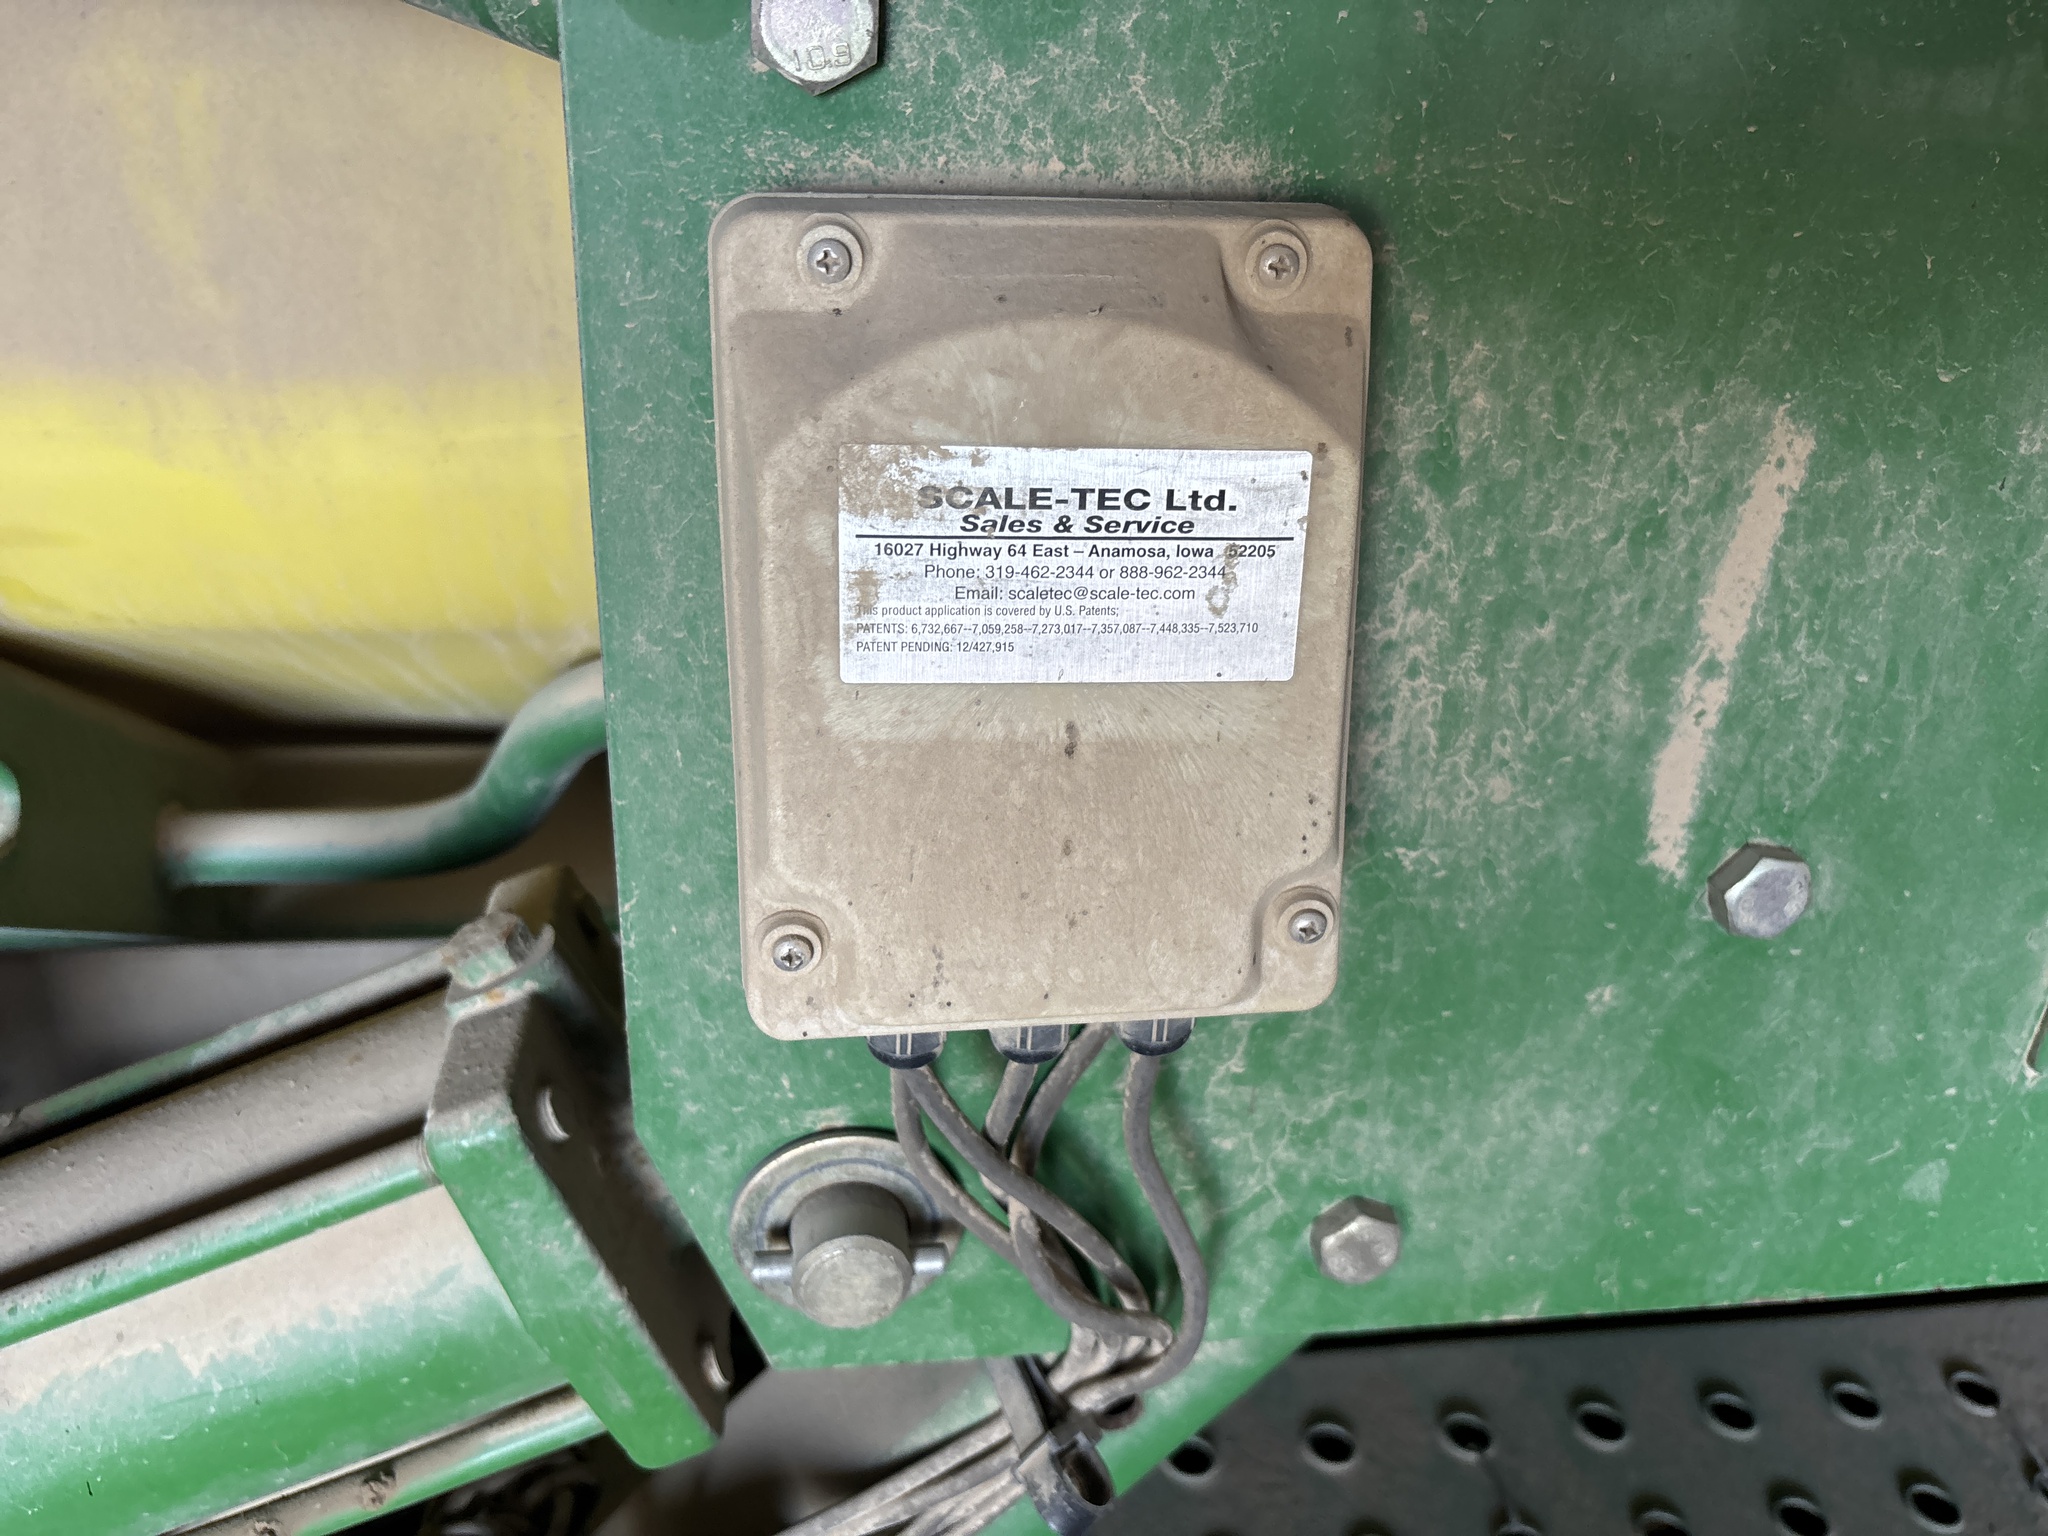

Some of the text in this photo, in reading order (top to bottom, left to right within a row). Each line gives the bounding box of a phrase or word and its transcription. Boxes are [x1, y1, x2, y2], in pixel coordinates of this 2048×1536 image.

[917, 484, 1237, 511] SCALE-TEC Ltd.
[959, 513, 1195, 534] Sales & Service
[874, 542, 924, 557] 16027
[929, 542, 1002, 560] Highway
[1007, 543, 1027, 557] 64
[1032, 543, 1069, 557] East
[1088, 544, 1171, 560] Anamosa,
[1176, 544, 1214, 557] Iowa
[1227, 544, 1276, 558] 52205
[924, 564, 1226, 579] Phone: 319-462-2344 or 888-962-2344
[955, 586, 1195, 600] Email: scaletec@scale-tec.com
[881, 605, 922, 618] product
[925, 605, 981, 618] application
[984, 605, 993, 615] is
[995, 605, 1035, 616] covered
[1039, 605, 1051, 618] by
[1054, 605, 1075, 616] U.S.
[1078, 605, 1119, 617] Patents;
[856, 623, 908, 634] PATENTS:
[856, 641, 1014, 653] PATENT PENDING: 12/427,915
